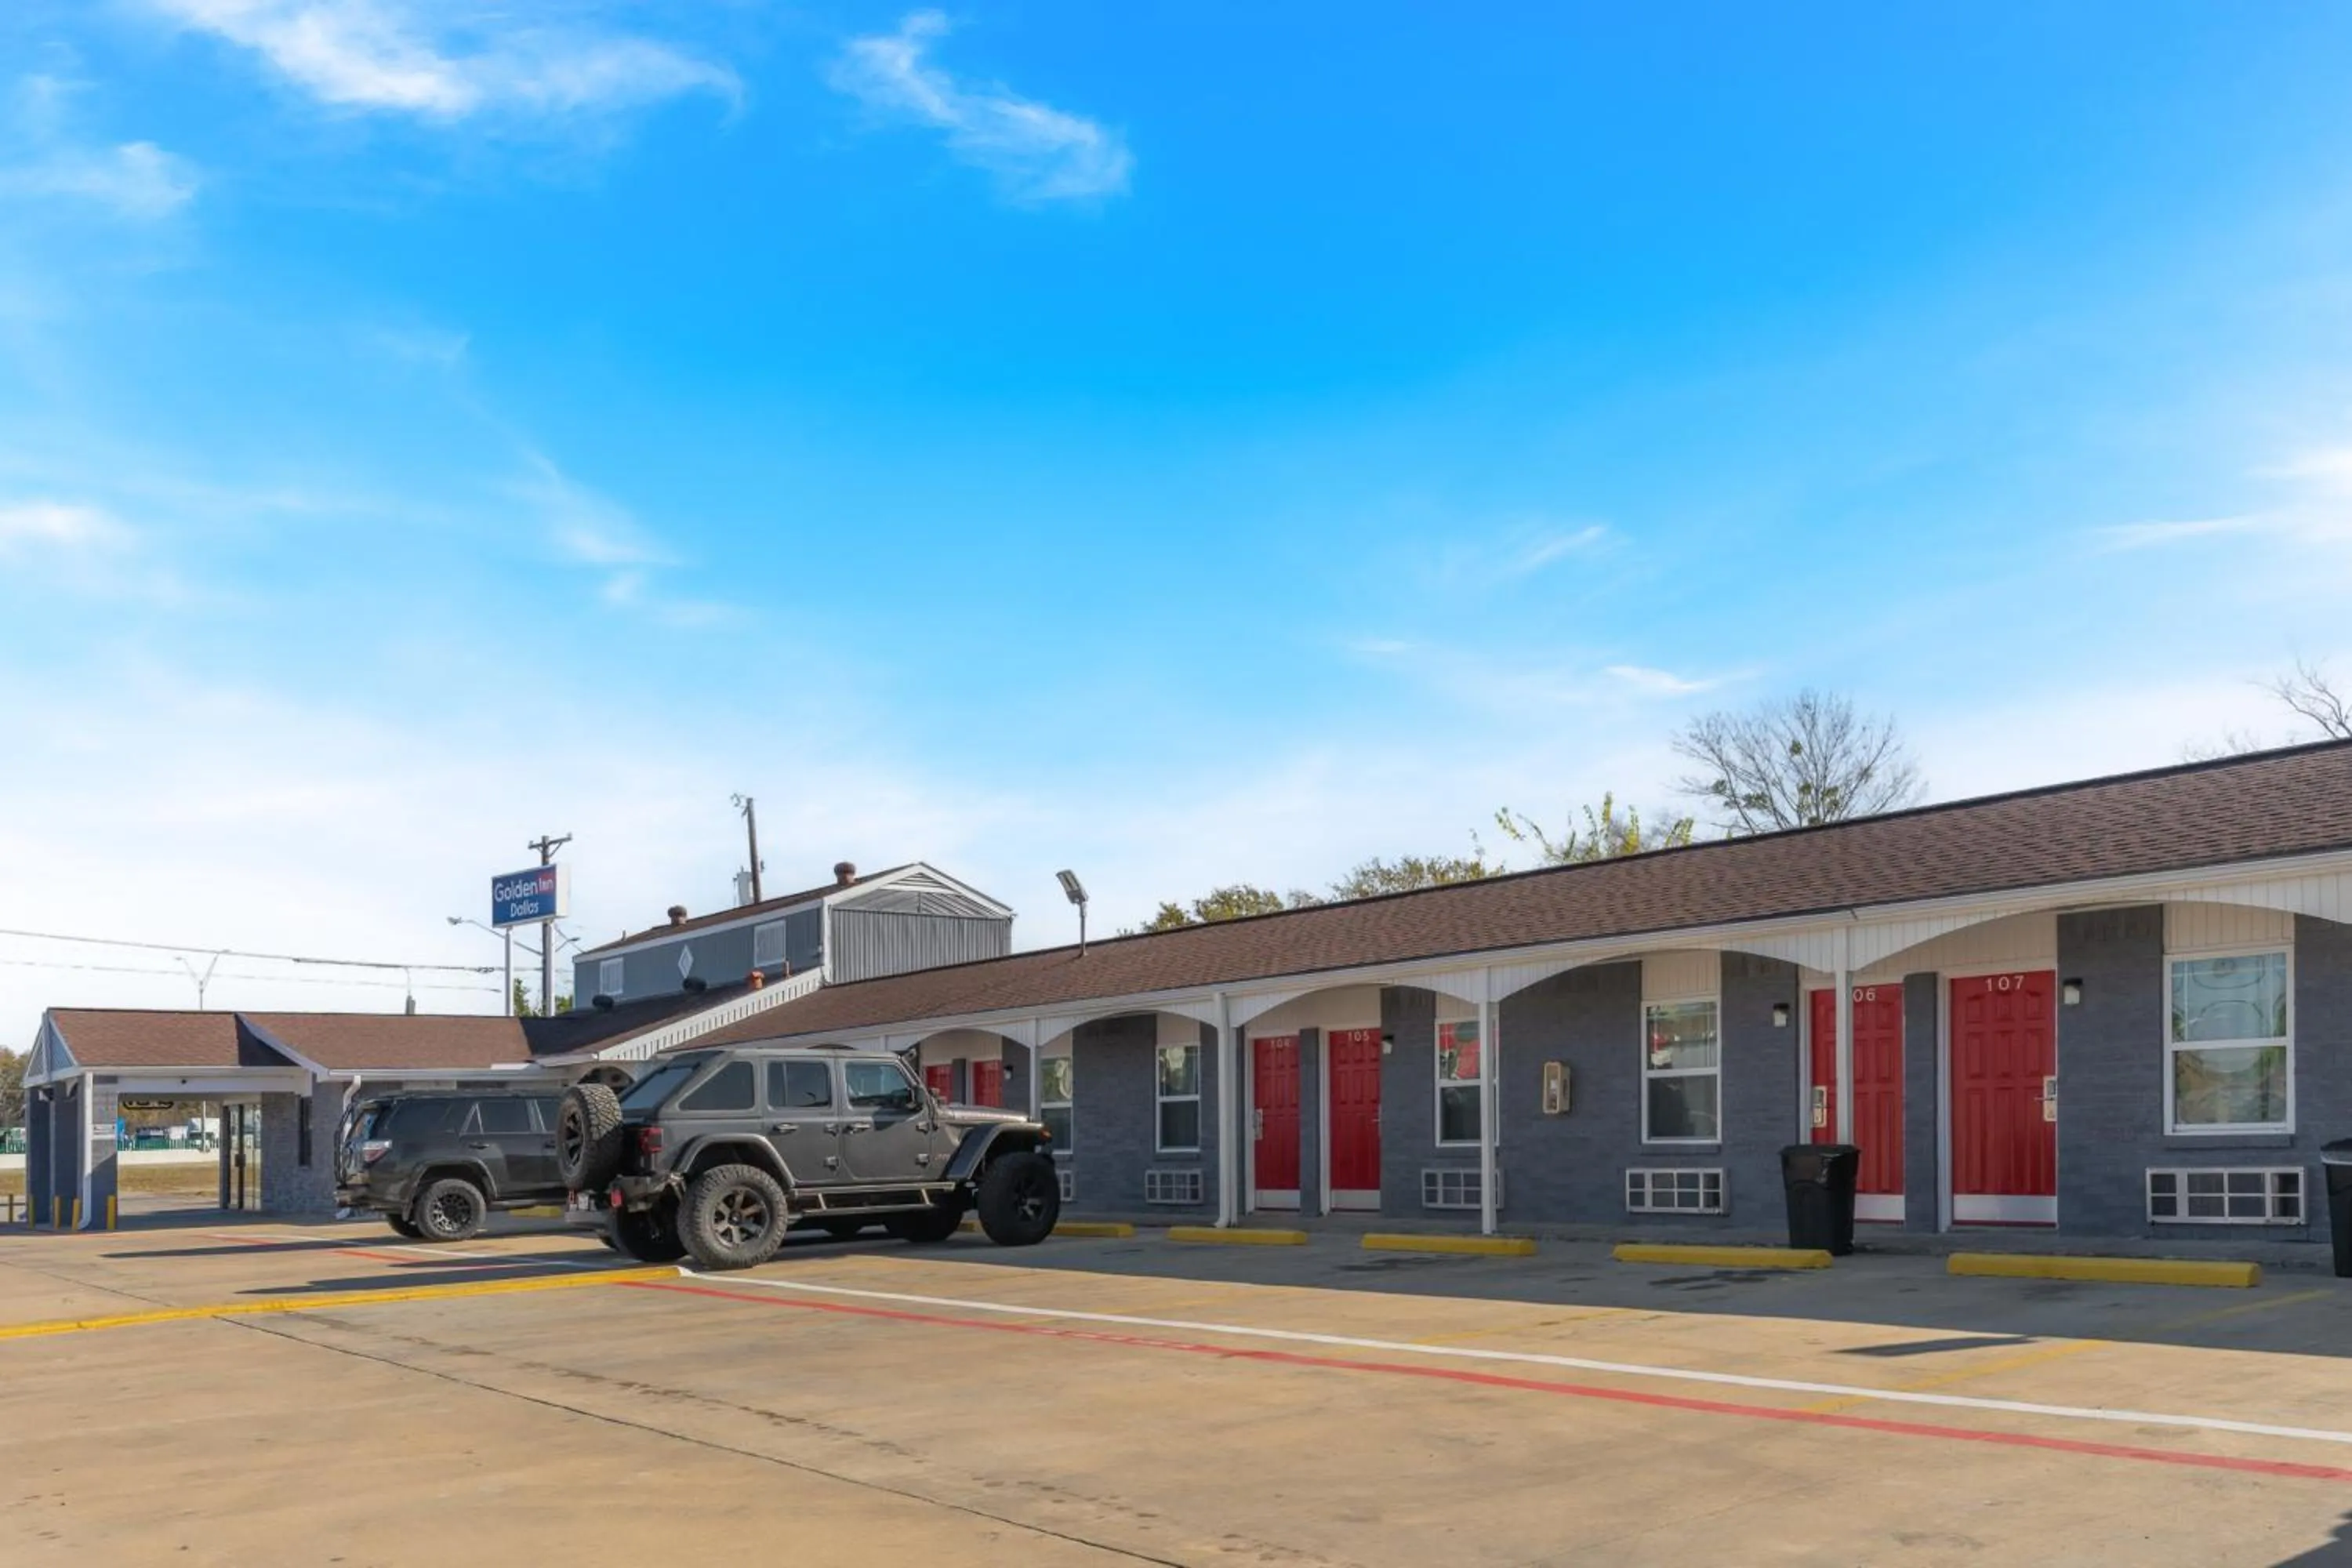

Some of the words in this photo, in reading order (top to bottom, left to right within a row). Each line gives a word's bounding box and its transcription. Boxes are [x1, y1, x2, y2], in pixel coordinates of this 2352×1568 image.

[494, 879, 539, 903] Golden
[539, 877, 554, 891] Inn
[510, 900, 539, 918] Dallas
[1985, 975, 2025, 992] 107
[1853, 988, 1876, 1003] 06
[1348, 1031, 1370, 1042] 105
